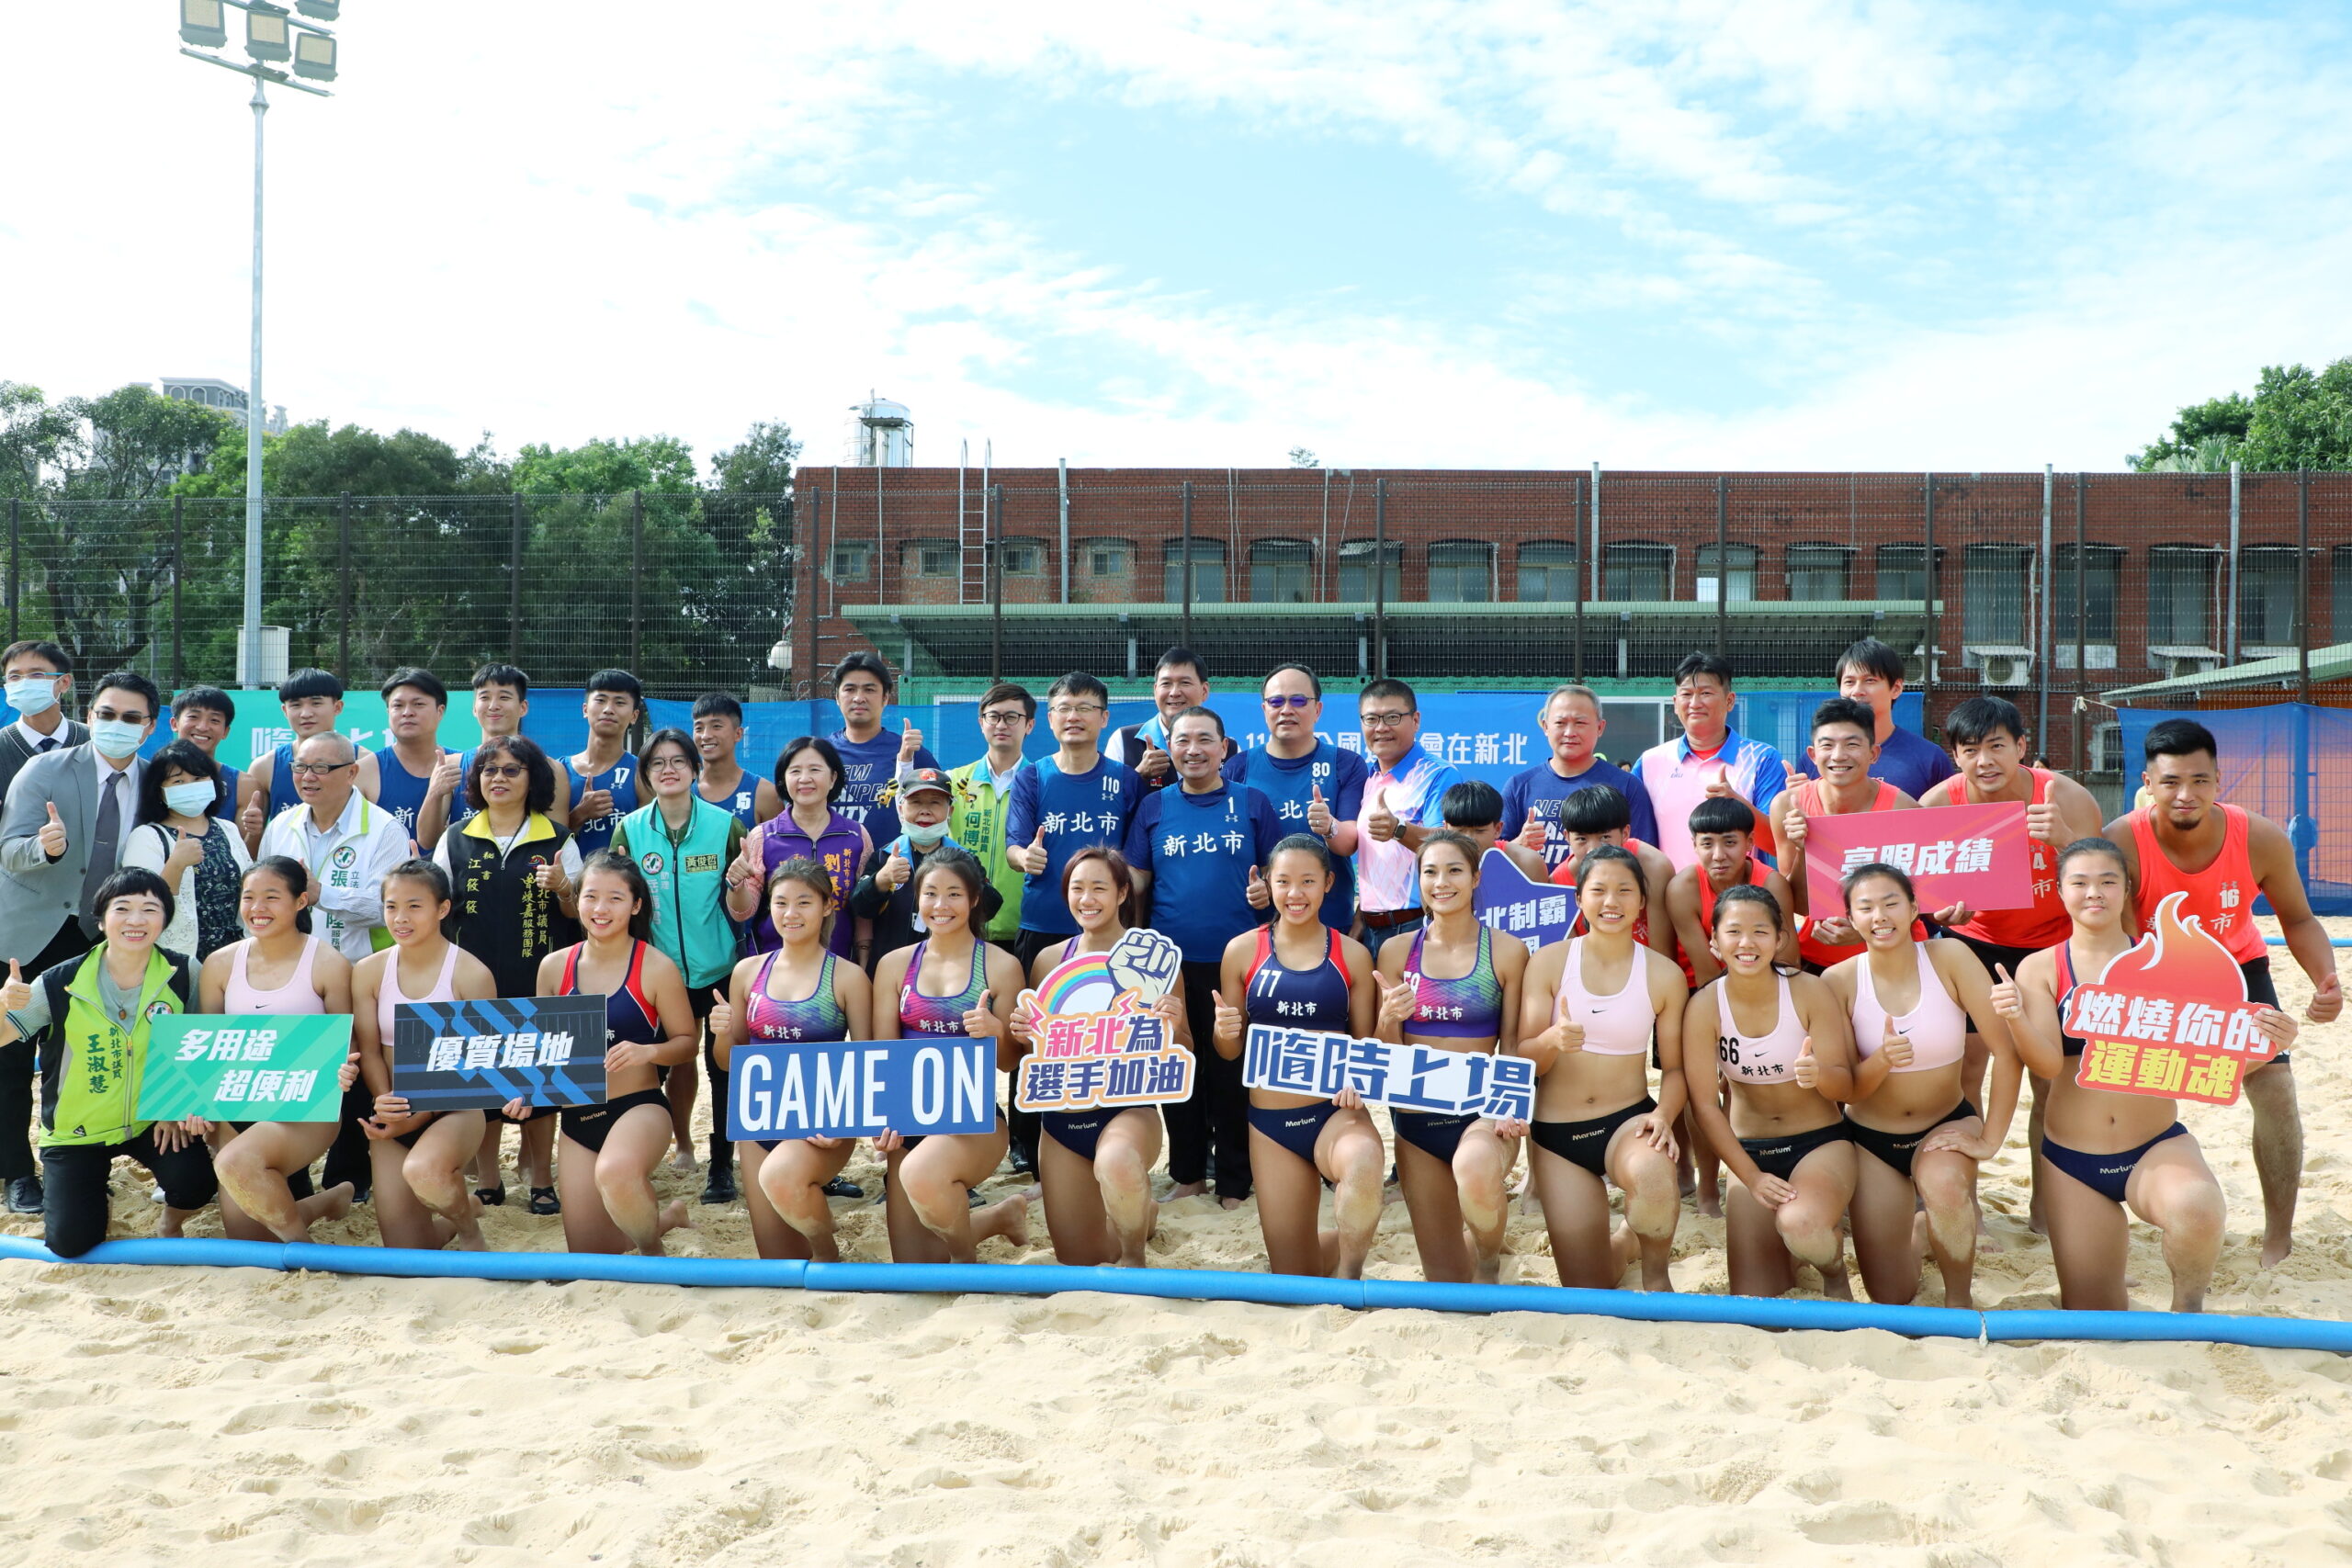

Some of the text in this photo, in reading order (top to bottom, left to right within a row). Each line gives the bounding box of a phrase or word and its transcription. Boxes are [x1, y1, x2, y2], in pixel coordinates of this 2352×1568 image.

[615, 767, 630, 784] 17
[1312, 762, 1330, 777] 80
[1102, 775, 1119, 794] 110
[736, 792, 752, 810] 15
[1227, 796, 1234, 813] 1
[1041, 812, 1120, 835] 新北市
[1162, 830, 1245, 857] 新北市
[1839, 837, 1993, 882] 亮眼成績
[2033, 852, 2047, 871] 4
[2031, 879, 2053, 898] 市
[2220, 889, 2240, 908] 16
[1474, 895, 1566, 931] 北制霸
[1257, 969, 1282, 997] 77
[1276, 1000, 1317, 1016] 新北市
[1419, 1005, 1464, 1021] 新北市
[763, 1024, 802, 1040] 新北市
[920, 1020, 959, 1033] 新北市
[2072, 989, 2274, 1055] 燃燒你的
[175, 1029, 277, 1062] 多用途
[1045, 1015, 1163, 1057] 新北為
[87, 1033, 109, 1093] 王淑慧
[426, 1031, 574, 1072] 優質場地
[1719, 1036, 1739, 1065] 66
[1025, 1055, 1185, 1101] 選手加油
[1246, 1028, 1532, 1121] 隨時上場
[1741, 1064, 1784, 1077] 新北市
[2085, 1040, 2239, 1099] 運動魂
[213, 1069, 319, 1102] 超便利
[739, 1045, 984, 1132] GAME ON
